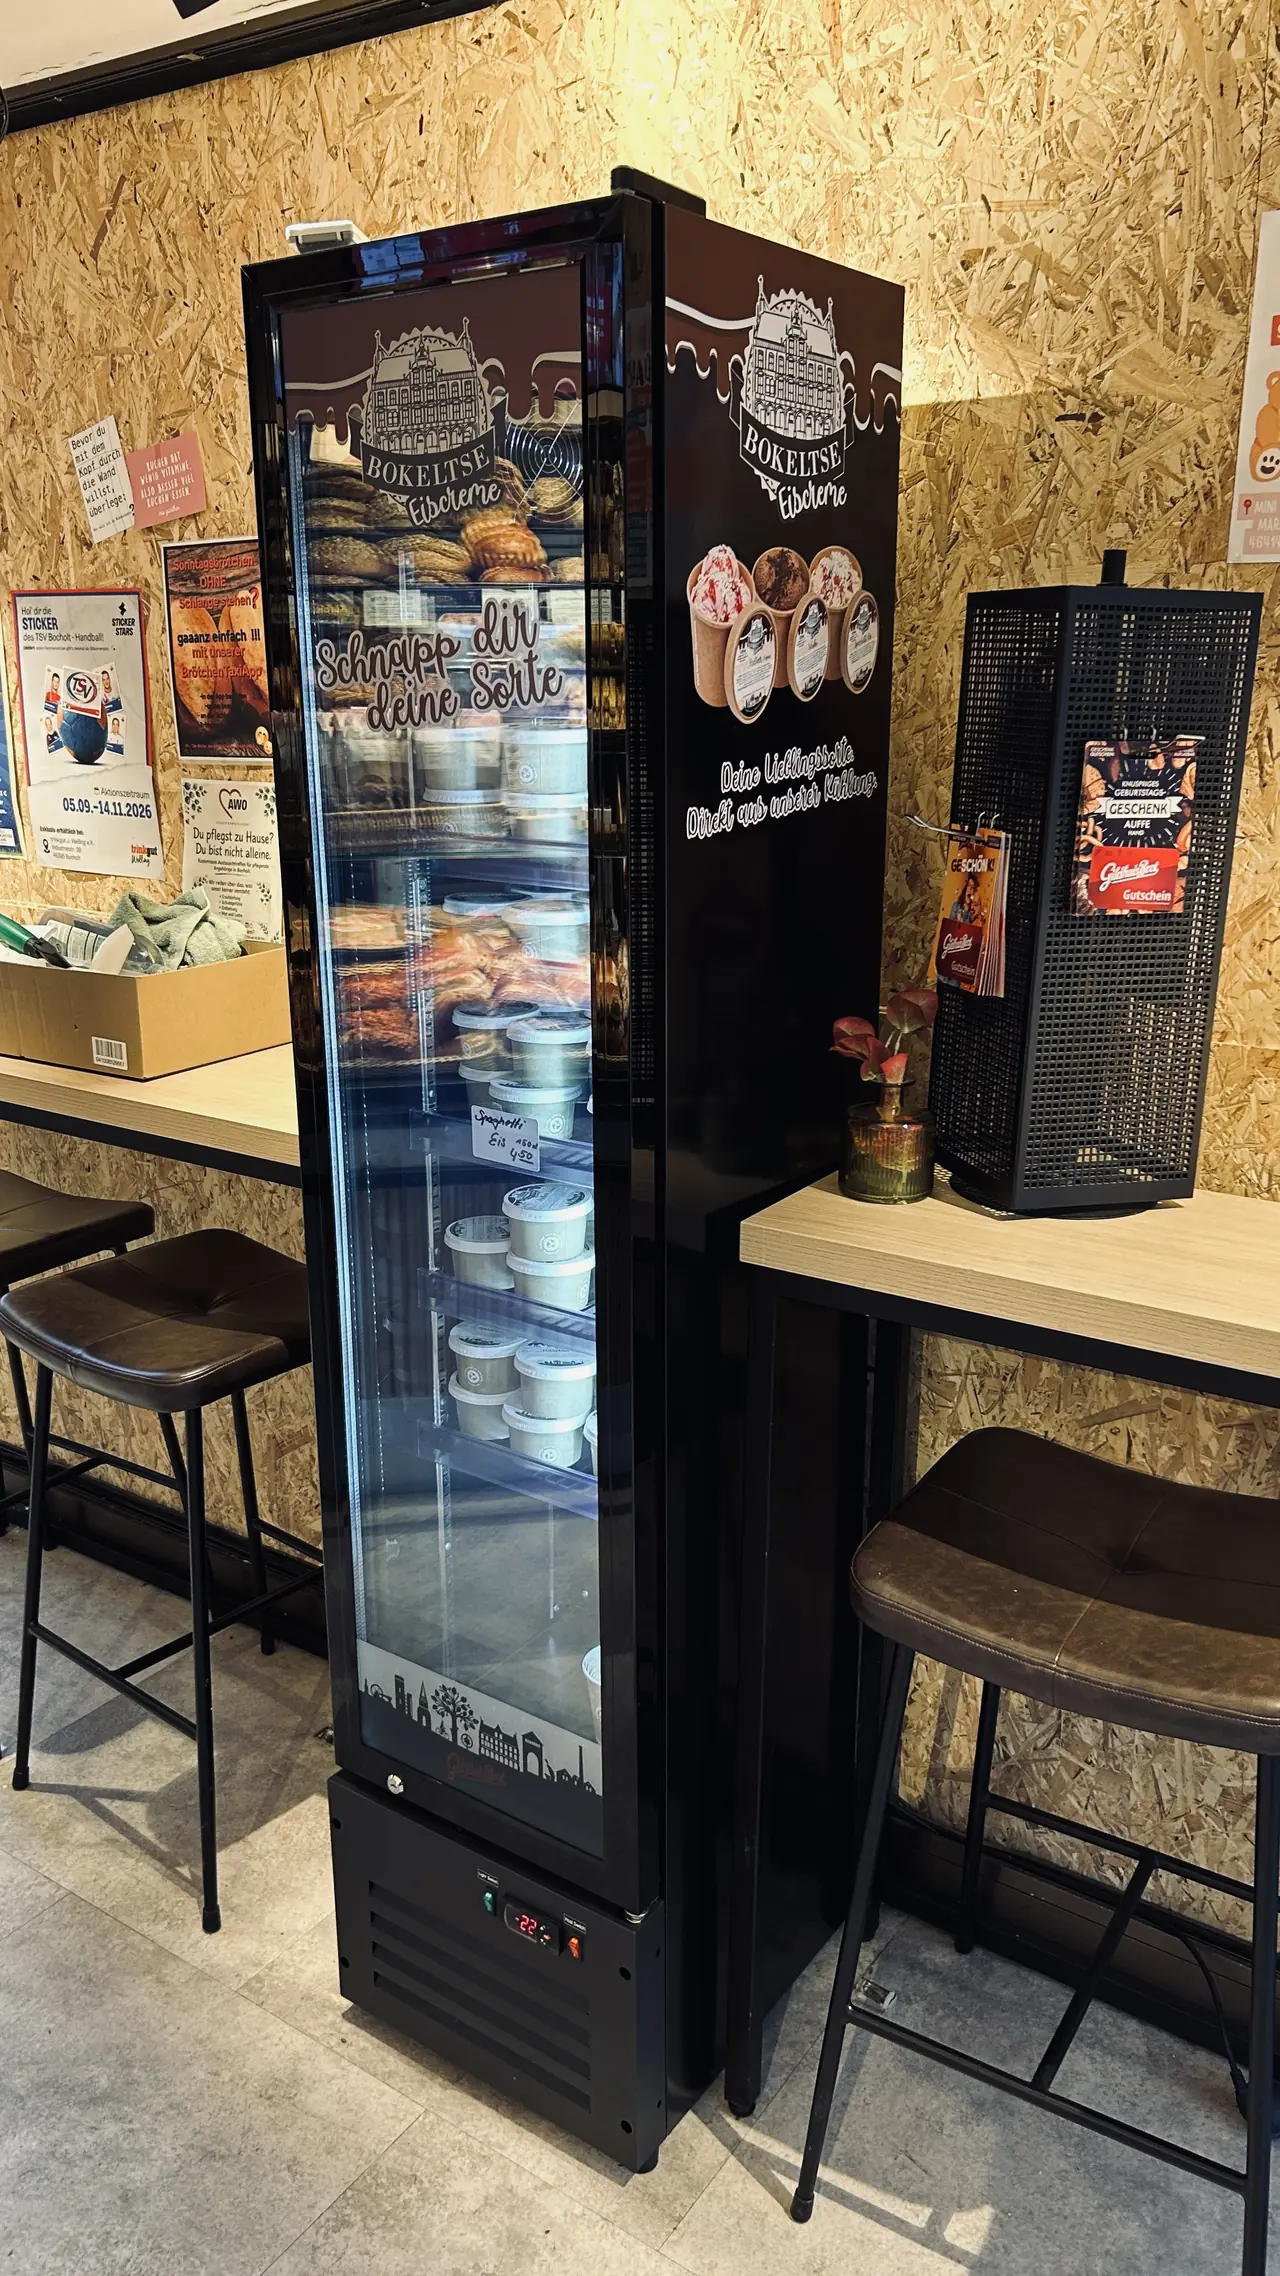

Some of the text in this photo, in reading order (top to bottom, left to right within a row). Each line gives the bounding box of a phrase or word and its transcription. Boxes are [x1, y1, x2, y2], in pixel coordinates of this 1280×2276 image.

[71, 425, 106, 450] Bevor du
[75, 442, 105, 463] mit dem
[743, 424, 841, 477] BOKELTSE
[78, 449, 121, 478] Kopf durch
[366, 444, 491, 488] BOKELTSE
[82, 466, 116, 491] die Wand
[157, 478, 179, 494] BESSER
[85, 484, 115, 504] willst,
[779, 481, 847, 520] Eiscreme
[407, 481, 501, 527] Eiscreme
[200, 576, 227, 589] OHNE
[180, 596, 219, 610] Schlange
[22, 617, 59, 630] STICKER
[111, 618, 136, 627] STICKER
[23, 633, 34, 642] des
[35, 633, 47, 642] TSV
[48, 632, 71, 642] Bocholt
[115, 628, 134, 636] STARS
[177, 632, 211, 647] gaaanz
[212, 629, 247, 642] einfach
[317, 632, 462, 687] Schnapp
[473, 599, 538, 654] dir
[192, 646, 245, 659] mit unserer
[71, 677, 93, 699] TSV
[366, 651, 563, 731] deine Sorte
[720, 760, 761, 793] Deine
[62, 797, 152, 819] 05.09.-14.11.2026
[228, 799, 248, 811] AWO
[686, 798, 734, 839] Direkt
[737, 795, 768, 827] aus
[770, 782, 821, 819] unserer
[1109, 802, 1168, 815] GESCHENK
[1123, 820, 1151, 829] AUFFE
[193, 827, 274, 845] Du pflegst zu Hause?
[131, 844, 158, 857] trinkgut
[196, 842, 206, 855] Du
[208, 844, 222, 856] bist
[225, 845, 243, 858] nicht
[951, 854, 995, 873] GESCHÖNK!
[1123, 889, 1171, 901] Gutschein
[475, 1109, 526, 1130] Spaghetti
[488, 1132, 506, 1147] Eis
